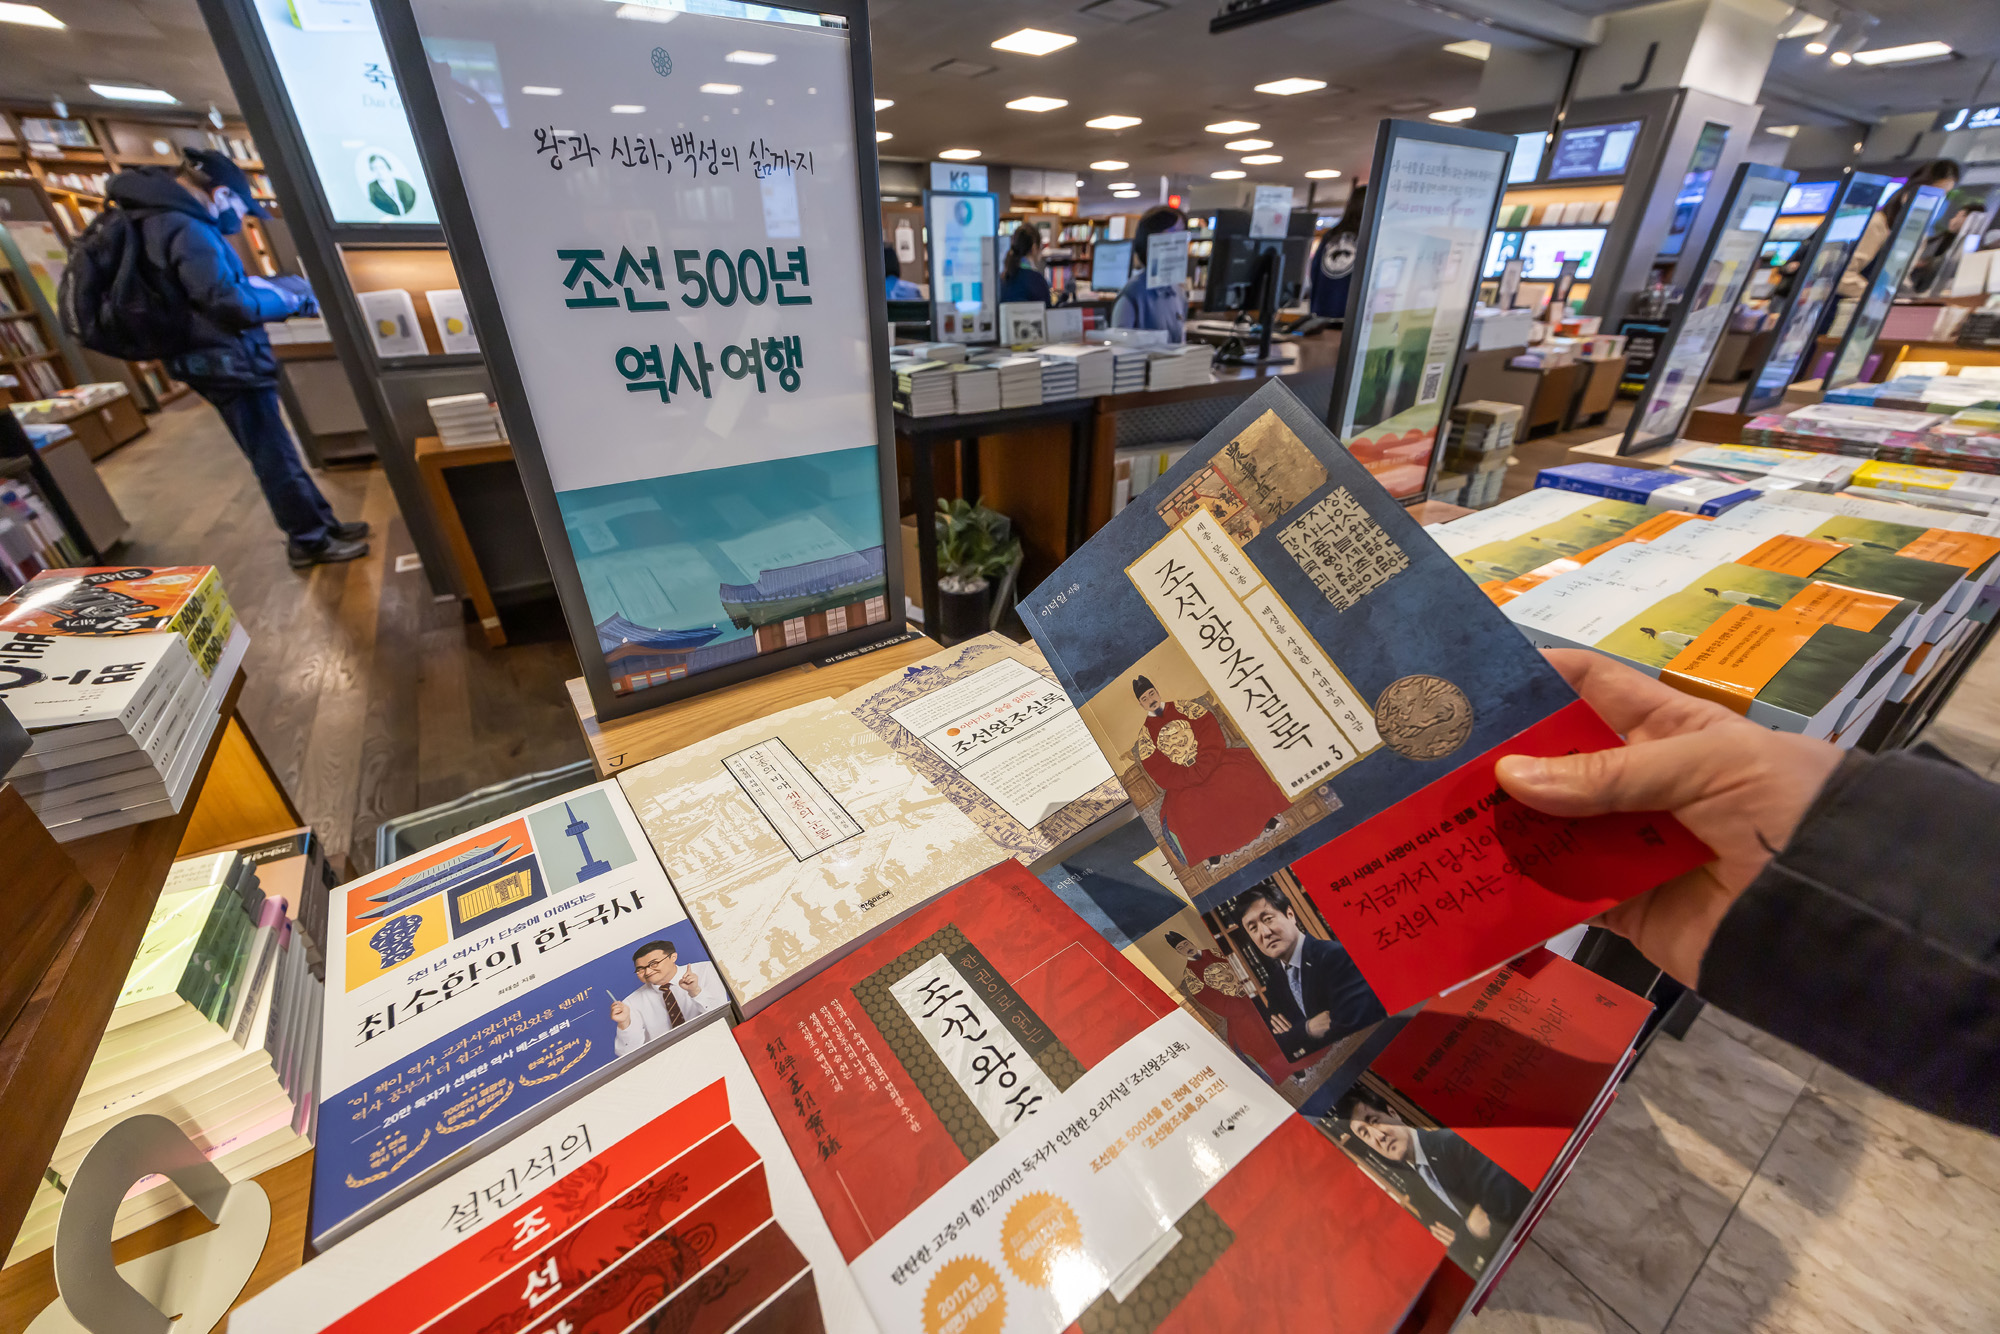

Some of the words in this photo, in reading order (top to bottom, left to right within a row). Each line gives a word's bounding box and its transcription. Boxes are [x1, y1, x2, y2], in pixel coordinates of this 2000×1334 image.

[534, 126, 601, 171] 왕과
[672, 131, 739, 178] 백성의
[748, 138, 815, 179] 삶까지
[949, 170, 970, 191] K8
[557, 246, 669, 312] 조선
[674, 245, 812, 308] 500년
[615, 342, 714, 404] 역사
[721, 336, 803, 393] 여행
[1041, 592, 1068, 618] 이덕일
[1066, 582, 1081, 598] 지음
[1154, 558, 1314, 750] 조선왕조실록
[1260, 605, 1288, 636] 백성을
[1286, 635, 1314, 665] 사랑한
[1311, 667, 1346, 709] 사대부의
[1343, 710, 1365, 733] 임금
[952, 692, 1066, 756] 조선왕조실록
[960, 711, 993, 729] 이야기로
[994, 703, 1012, 713] 술술
[607, 752, 629, 767] J
[1328, 744, 1343, 760] 3
[750, 750, 776, 775] 단종의
[770, 773, 791, 790] 비애
[785, 790, 814, 818] 세종의
[807, 820, 831, 839] 눈물
[1056, 872, 1083, 890] 이덕일
[1329, 875, 1353, 894] 우리
[1353, 858, 1385, 883] 시대의
[1384, 839, 1417, 863] 사관이
[1416, 824, 1440, 844] 다시
[1440, 819, 1454, 834] 쓴
[1454, 806, 1478, 825] 정통
[1436, 825, 1505, 873] 당신이
[407, 967, 429, 984] 5천
[434, 958, 448, 973] 년
[452, 937, 495, 960] 역사가
[499, 914, 540, 940] 단숨에
[544, 892, 595, 919] 이해되는
[1373, 904, 1441, 951] 조선의
[1435, 868, 1506, 916] 역사는
[355, 942, 521, 1047] 최소한의
[535, 890, 645, 954] 한국사
[959, 953, 979, 970] 한
[975, 968, 1014, 1013] 권으로
[1011, 1010, 1045, 1044] 읽는
[1508, 987, 1541, 1015] 알던
[1472, 998, 1489, 1013] 정통
[352, 1101, 382, 1121] 역사
[387, 1073, 433, 1102] 공부가
[437, 1062, 451, 1073] 더
[455, 1045, 484, 1065] 쉽고
[488, 1007, 555, 1046] 재미있었을
[374, 1073, 402, 1093] 책이
[408, 1056, 437, 1075] 역사
[442, 1009, 523, 1062] 교과서였다면
[383, 1105, 411, 1128] 20만
[414, 1084, 451, 1109] 독자가
[452, 1062, 488, 1087] 선택한
[490, 1049, 514, 1065] 역사
[516, 1019, 570, 1053] 베스트셀러
[528, 1052, 553, 1071] 한국사
[555, 1038, 580, 1058] 교과서
[547, 1055, 565, 1069] 저자
[797, 1021, 817, 1048] 조선왕조
[813, 1048, 834, 1077] 오백년의
[830, 1075, 843, 1093] 기록
[809, 1012, 829, 1039] 생생하게
[825, 1039, 837, 1053] 살아
[833, 1054, 842, 1063] 숨
[839, 1062, 852, 1079] 쉬는
[830, 998, 847, 1019] 안정과
[844, 1017, 856, 1032] 질서
[853, 1032, 870, 1053] 속에서
[865, 1052, 889, 1082] 끊임없이
[884, 1081, 904, 1107] 변화를
[901, 1107, 921, 1132] 추구한
[832, 1025, 857, 1060] 인본주의의
[853, 1059, 866, 1075] 나라
[864, 1075, 878, 1091] 조선
[447, 1105, 475, 1124] 한국사
[1089, 1137, 1129, 1174] 조선왕조
[1125, 1106, 1164, 1142] 500년을
[1161, 1099, 1174, 1111] 한
[1171, 1084, 1192, 1102] 권에
[1188, 1065, 1217, 1088] 담아낸
[1204, 1078, 1229, 1099] 고전!
[369, 1145, 386, 1162] 3년
[441, 1124, 593, 1233] 설민석의
[890, 1245, 934, 1287] 탄탄한
[931, 1212, 972, 1251] 고증의
[970, 1196, 990, 1218] 힘!
[988, 1167, 1024, 1204] 200만
[1022, 1141, 1059, 1174] 독자가
[1055, 1117, 1092, 1148] 인정한
[1089, 1082, 1131, 1123] 오리지널
[937, 1272, 980, 1320] 2017년
